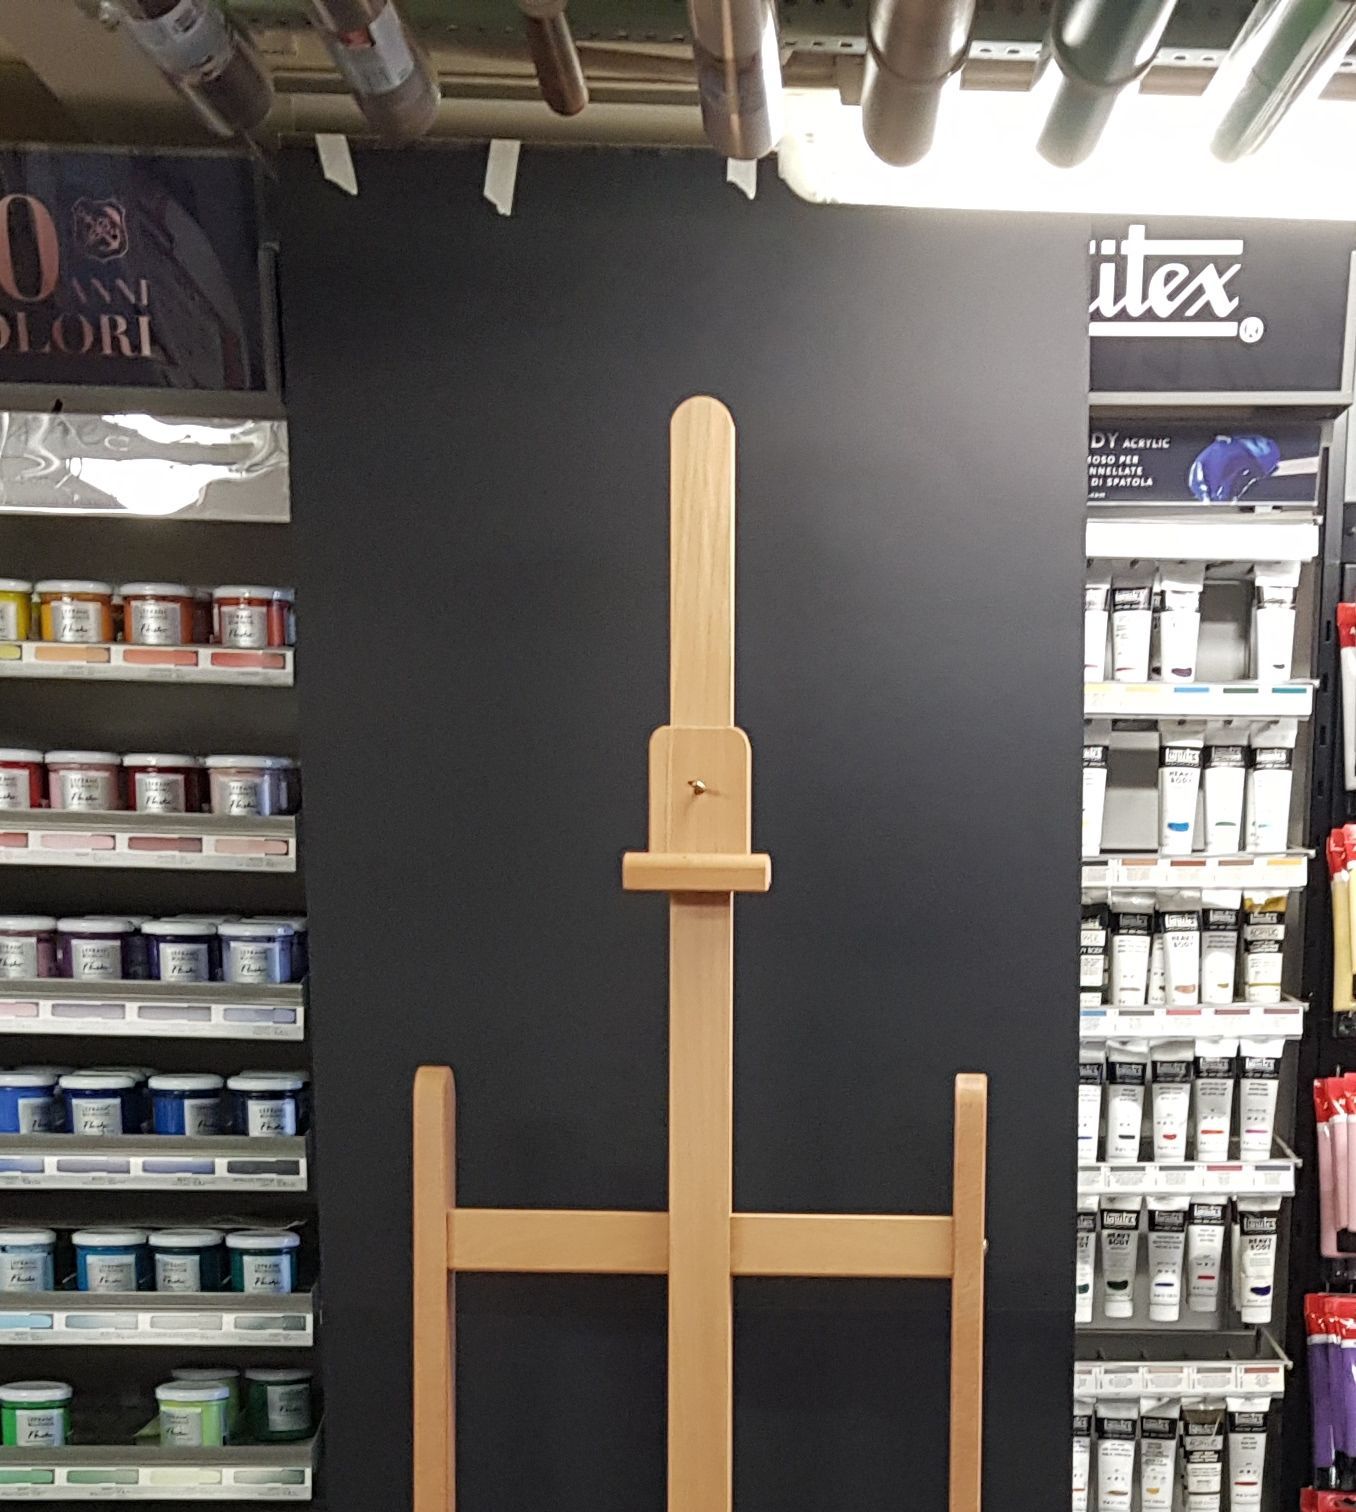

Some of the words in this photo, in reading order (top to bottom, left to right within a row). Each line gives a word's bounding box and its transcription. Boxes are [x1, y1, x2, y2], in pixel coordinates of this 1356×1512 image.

[0, 311, 152, 357] LORI
[1091, 432, 1119, 448] DY
[1122, 438, 1170, 448] ACRYLIC
[1119, 455, 1139, 464] PER
[1091, 477, 1103, 487] DI
[1106, 477, 1153, 487] SPATOLA
